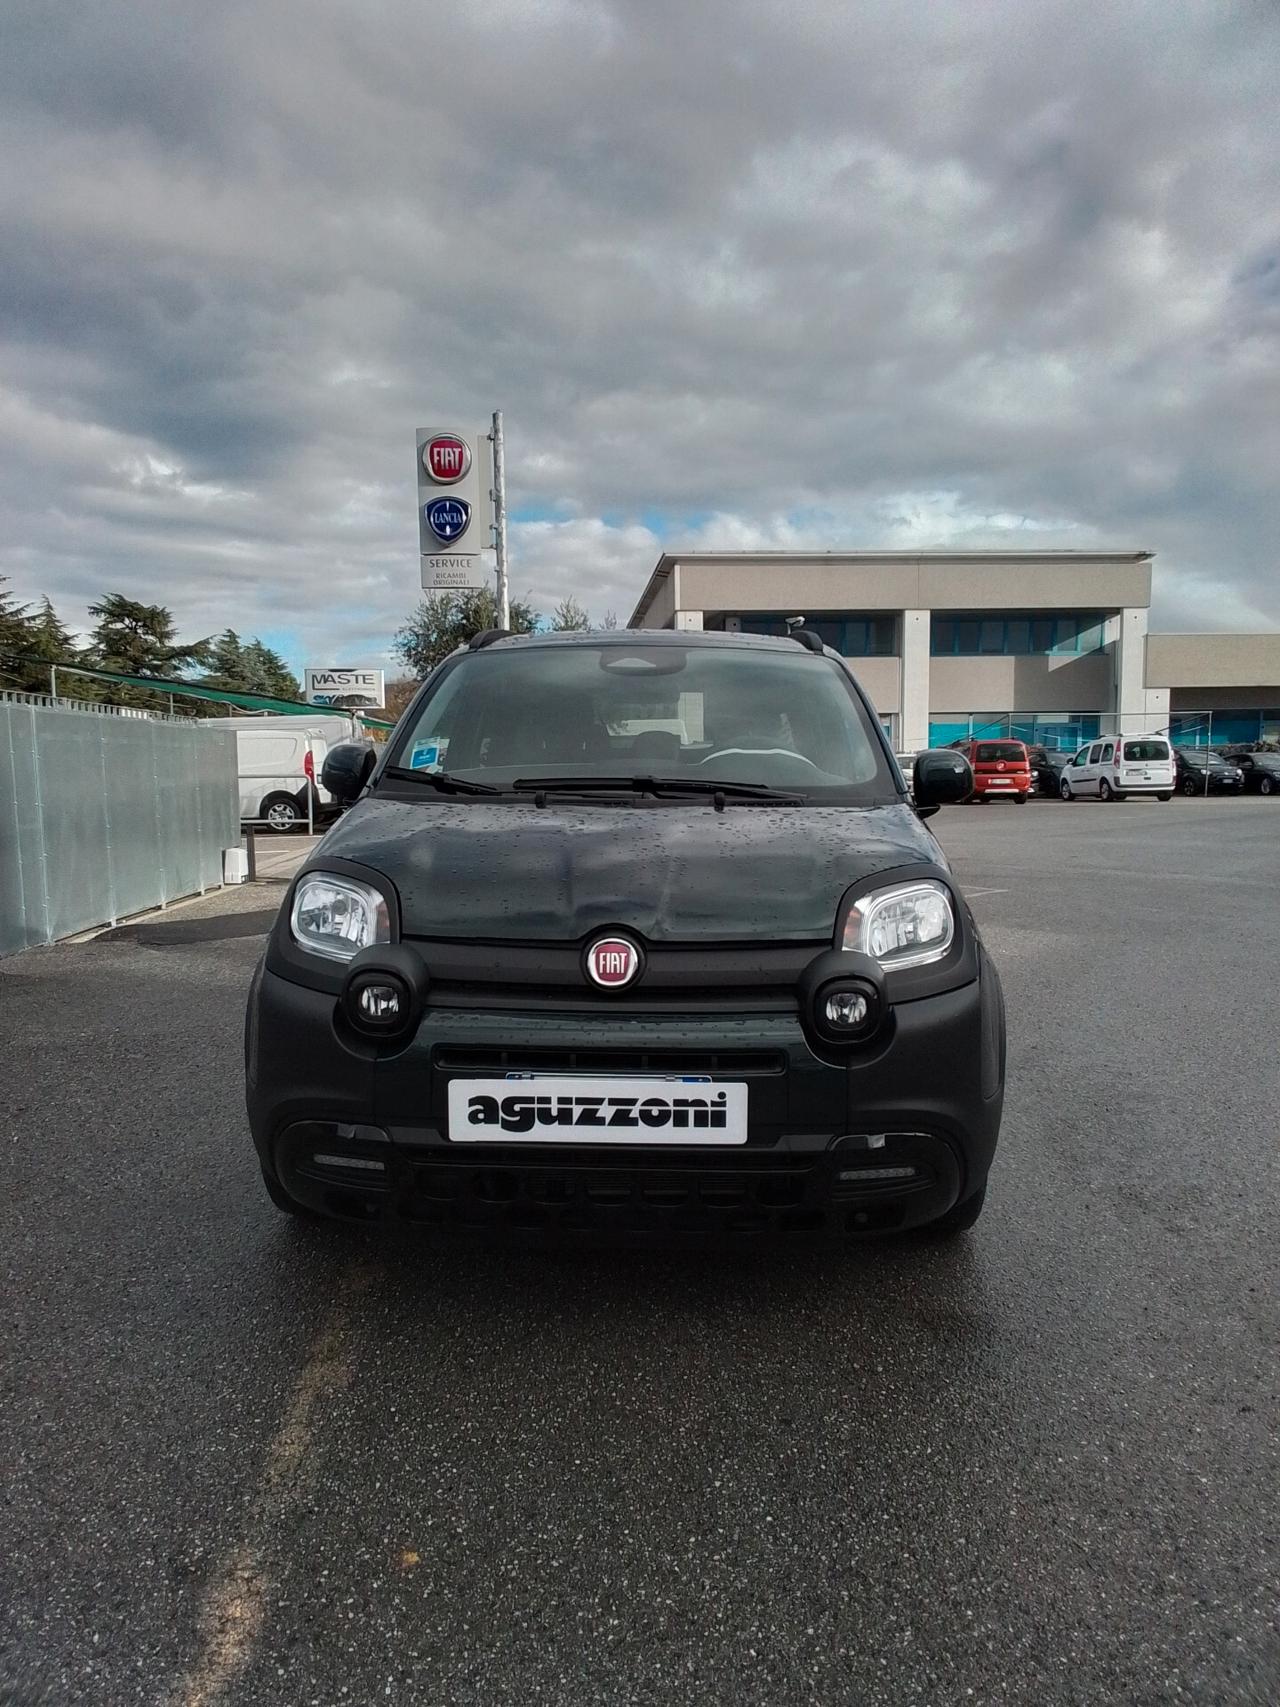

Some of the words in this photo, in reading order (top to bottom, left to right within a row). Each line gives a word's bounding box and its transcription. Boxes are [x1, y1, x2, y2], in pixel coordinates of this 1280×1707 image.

[433, 447, 462, 470] FIAT
[434, 512, 462, 524] LANCIA
[429, 559, 472, 568] SERVICE
[311, 673, 375, 685] MASTE
[599, 952, 627, 974] FIAT
[467, 1091, 727, 1133] aguzzoni
